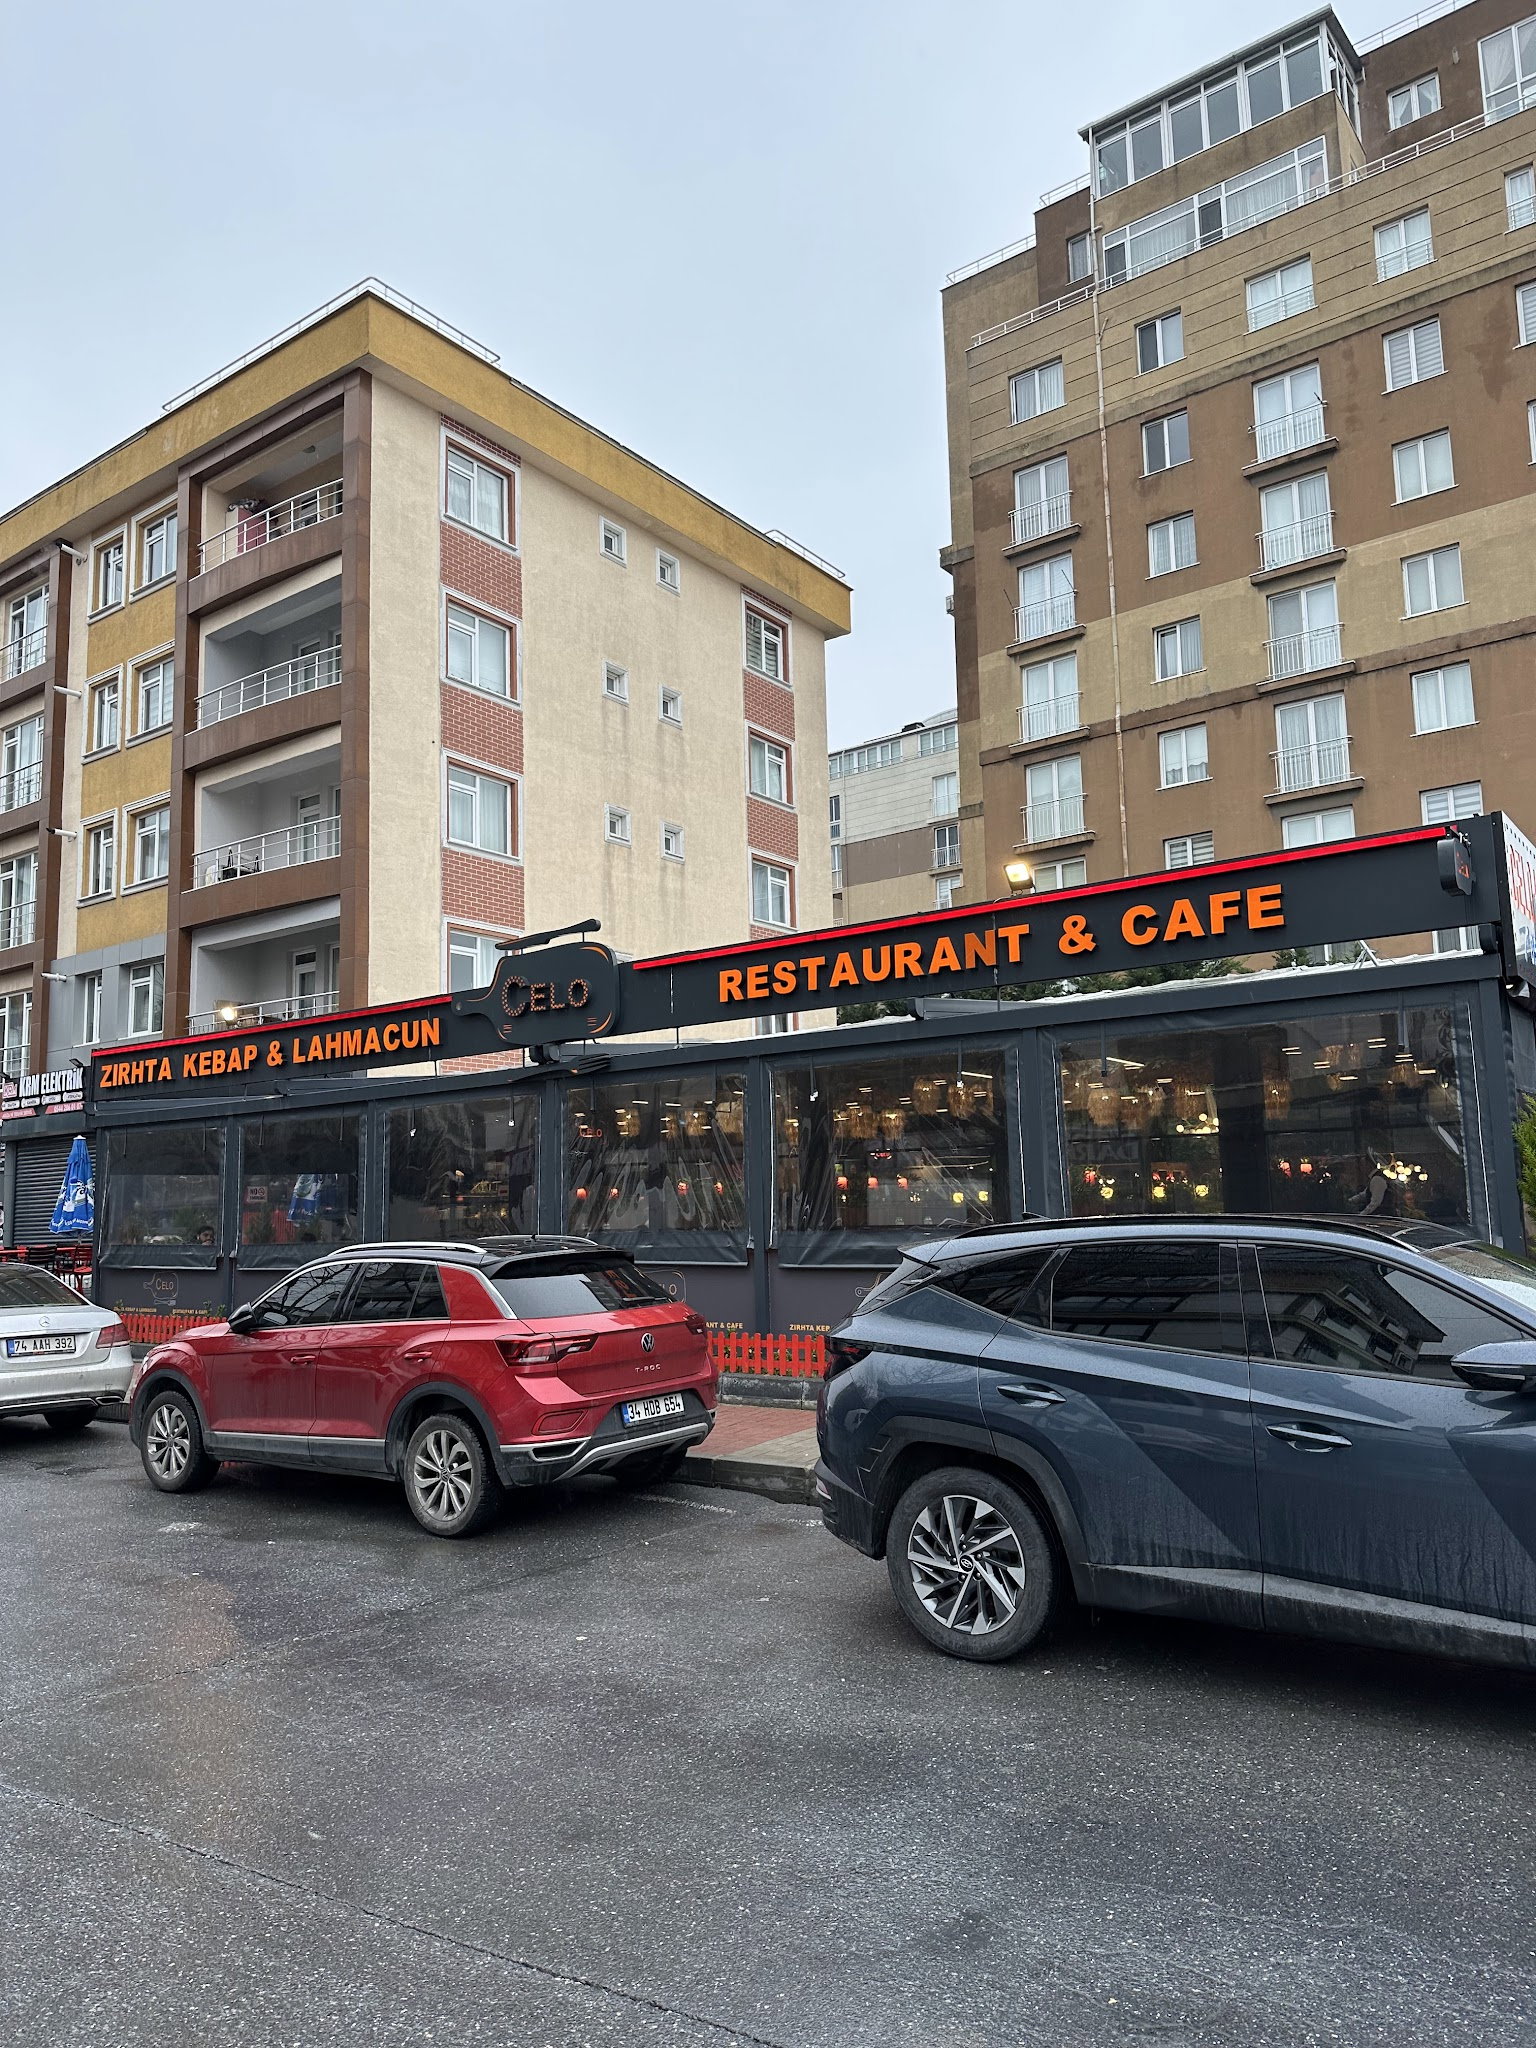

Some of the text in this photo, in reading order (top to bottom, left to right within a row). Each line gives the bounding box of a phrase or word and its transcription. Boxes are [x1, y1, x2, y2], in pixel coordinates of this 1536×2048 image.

[719, 884, 1286, 1003] RESTAURANT & CAFE
[100, 1018, 441, 1088] ZIRHTA KEBAP & LAHMACUN
[19, 1074, 40, 1097] KRM
[15, 1337, 73, 1352] 74 AAH 392
[635, 1363, 661, 1374] T-ROC
[628, 1395, 681, 1420] 34 HDB 654
